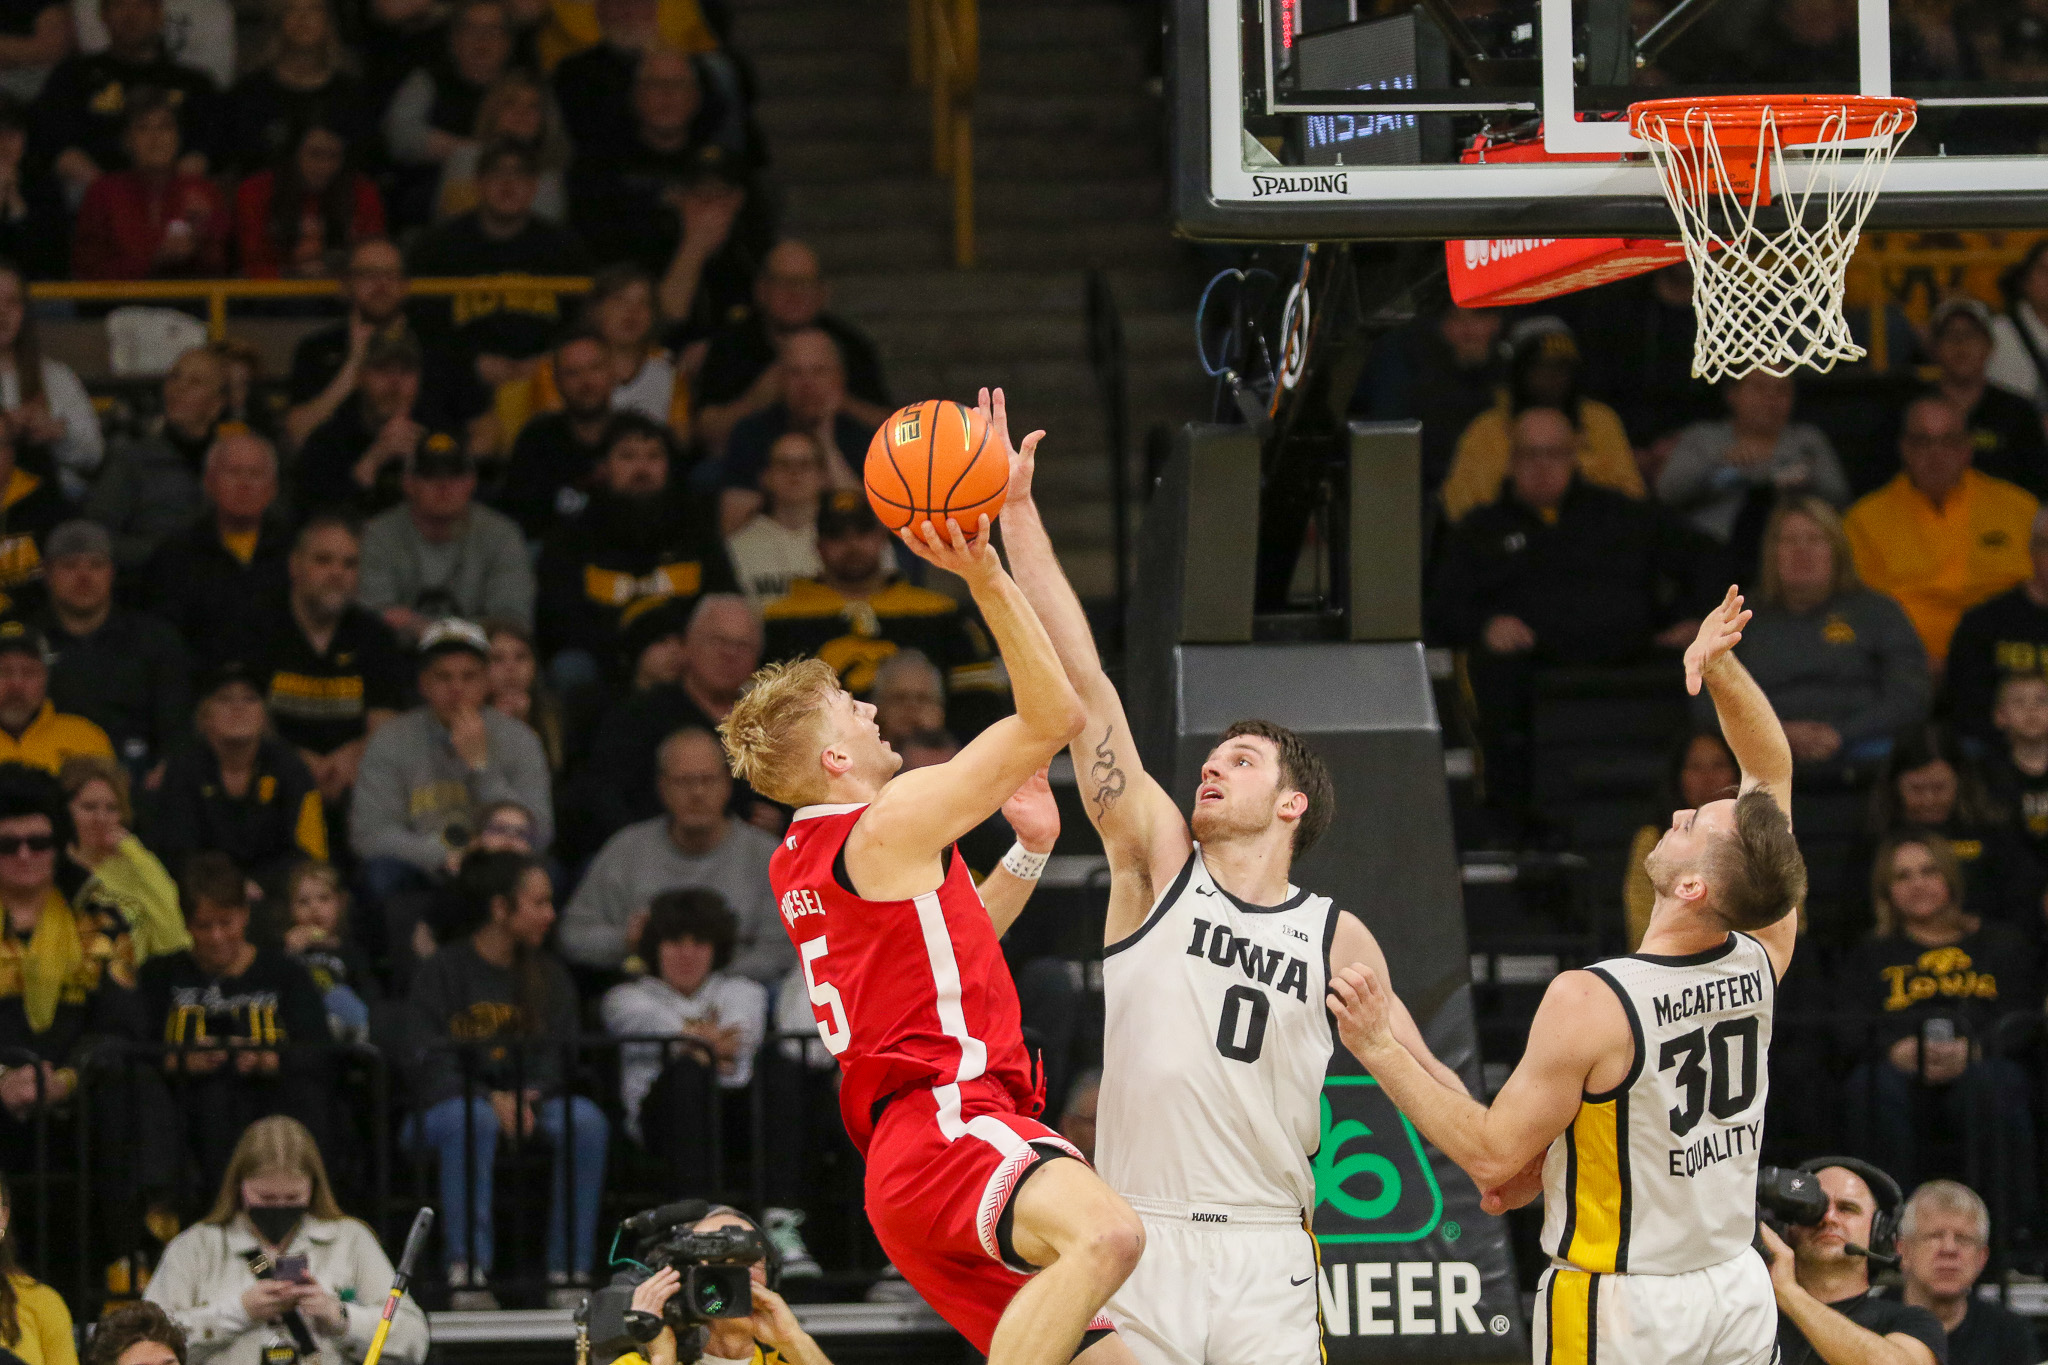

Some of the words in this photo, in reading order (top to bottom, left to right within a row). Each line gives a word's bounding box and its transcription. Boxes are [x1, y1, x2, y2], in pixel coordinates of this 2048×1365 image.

[1252, 172, 1349, 198] SPALDING
[800, 934, 851, 1056] 5
[1186, 917, 1309, 1004] IOWA
[1653, 970, 1763, 1027] McCAFFERY
[1216, 984, 1271, 1064] 0
[1658, 1015, 1760, 1138] 30
[1669, 1119, 1761, 1178] EQUALITY
[1191, 1212, 1228, 1223] HAWKS
[1319, 1261, 1487, 1337] NEER
